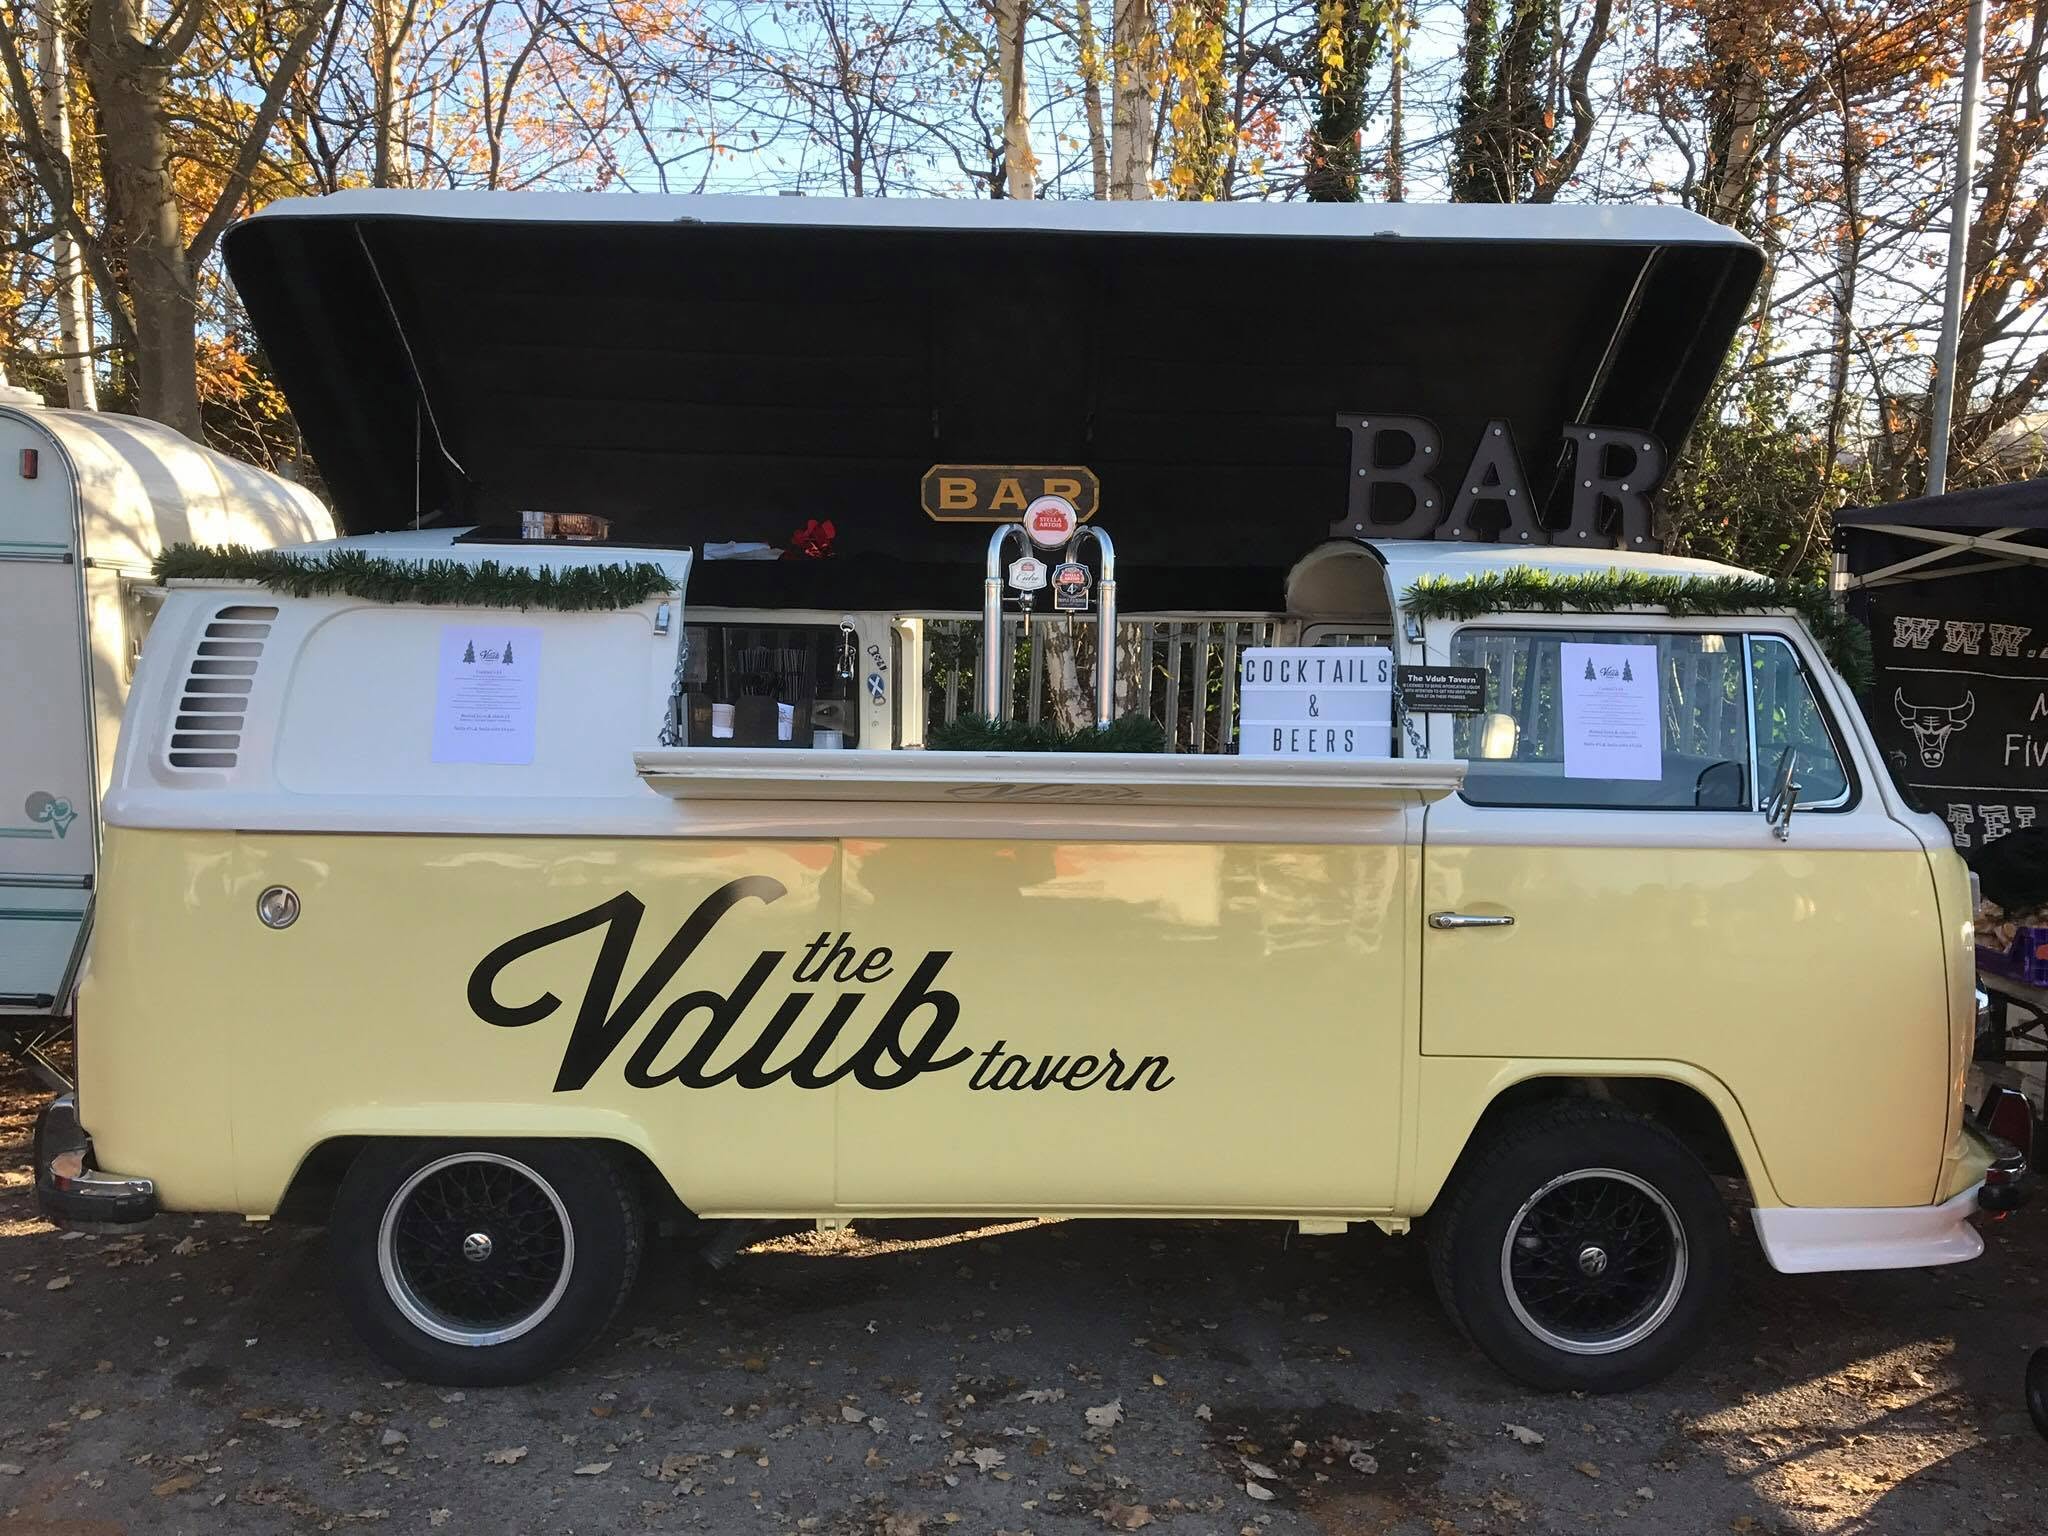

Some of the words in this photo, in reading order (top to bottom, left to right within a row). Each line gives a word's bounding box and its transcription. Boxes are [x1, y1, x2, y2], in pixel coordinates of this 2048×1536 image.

[939, 477, 1082, 510] BAR
[1329, 412, 1672, 551] BAR
[1892, 616, 2048, 658] WWW.
[1246, 659, 1388, 683] COCKTAILS
[1407, 674, 1423, 682] The
[1425, 675, 1447, 683] Vdub
[1448, 675, 1476, 684] Tavern
[1308, 694, 1319, 717] &
[1273, 728, 1354, 753] BEERS
[792, 932, 894, 983] the
[467, 875, 973, 1093] Vdub
[968, 1040, 1175, 1092] tavern
